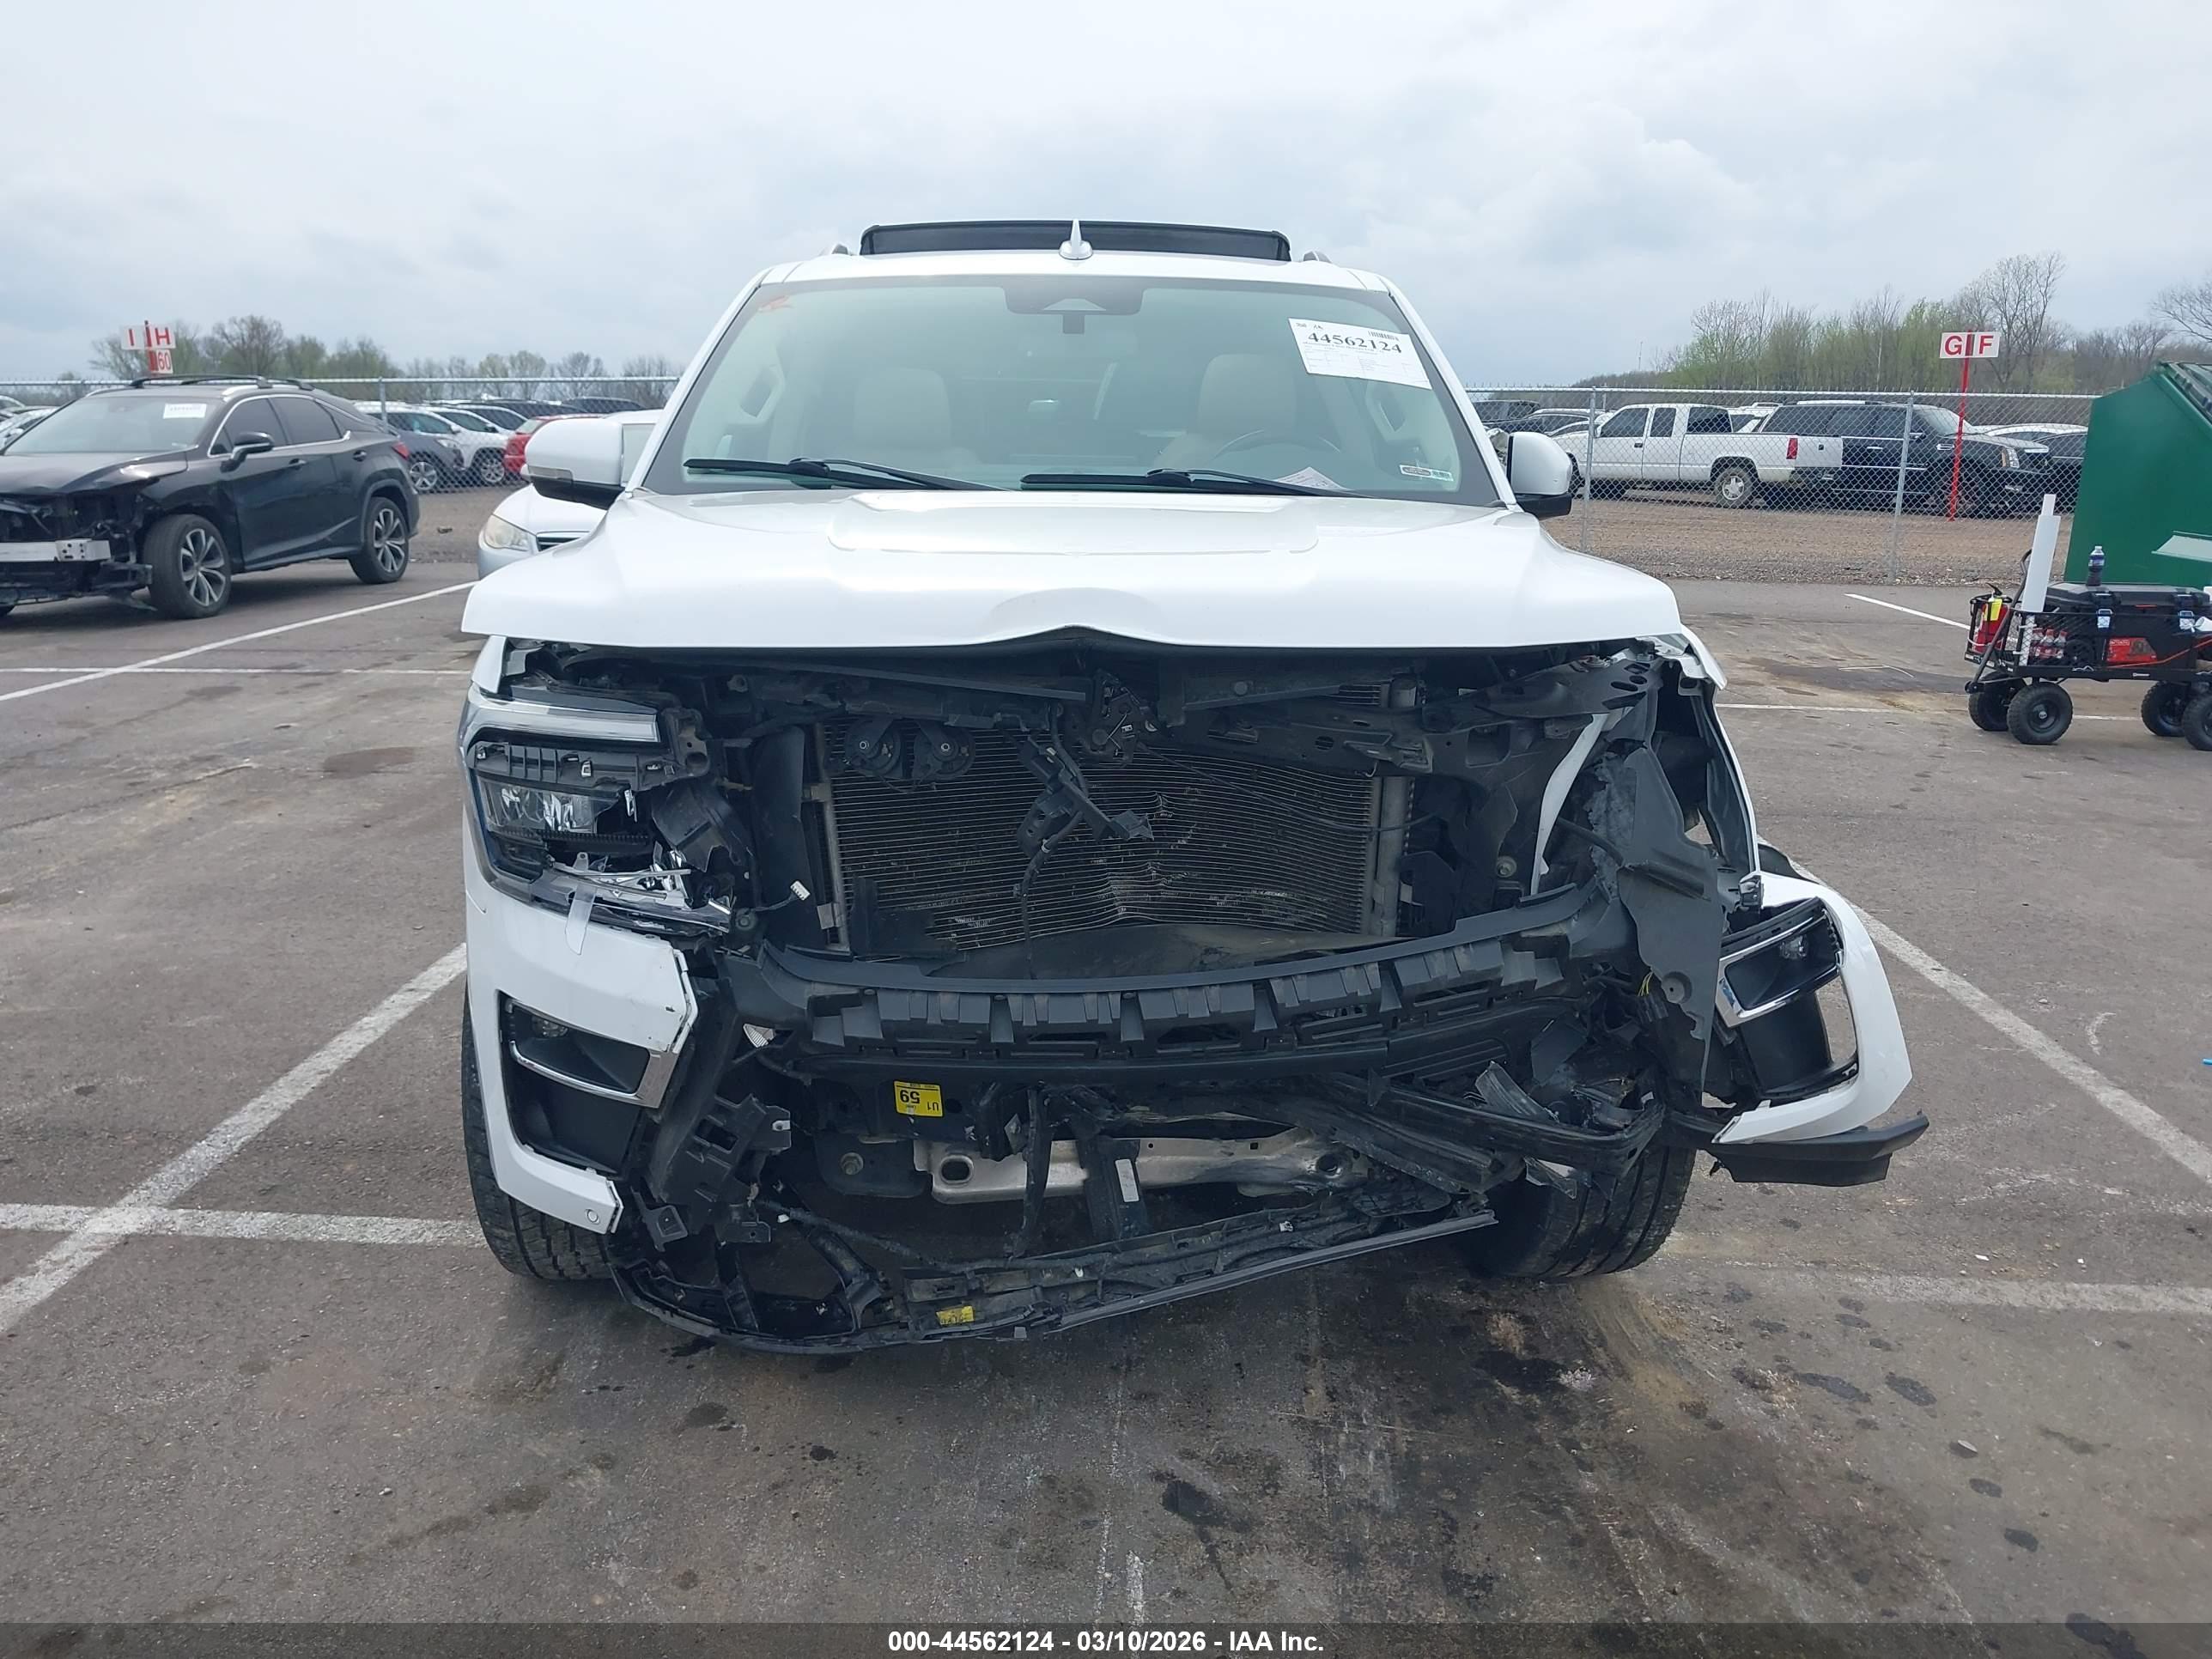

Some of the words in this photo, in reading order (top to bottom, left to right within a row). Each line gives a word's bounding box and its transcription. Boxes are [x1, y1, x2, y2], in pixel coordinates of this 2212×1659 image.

[1308, 331, 1402, 354] 44562124
[157, 351, 171, 370] 60
[900, 1090, 921, 1103] 59
[927, 1102, 939, 1111] U1
